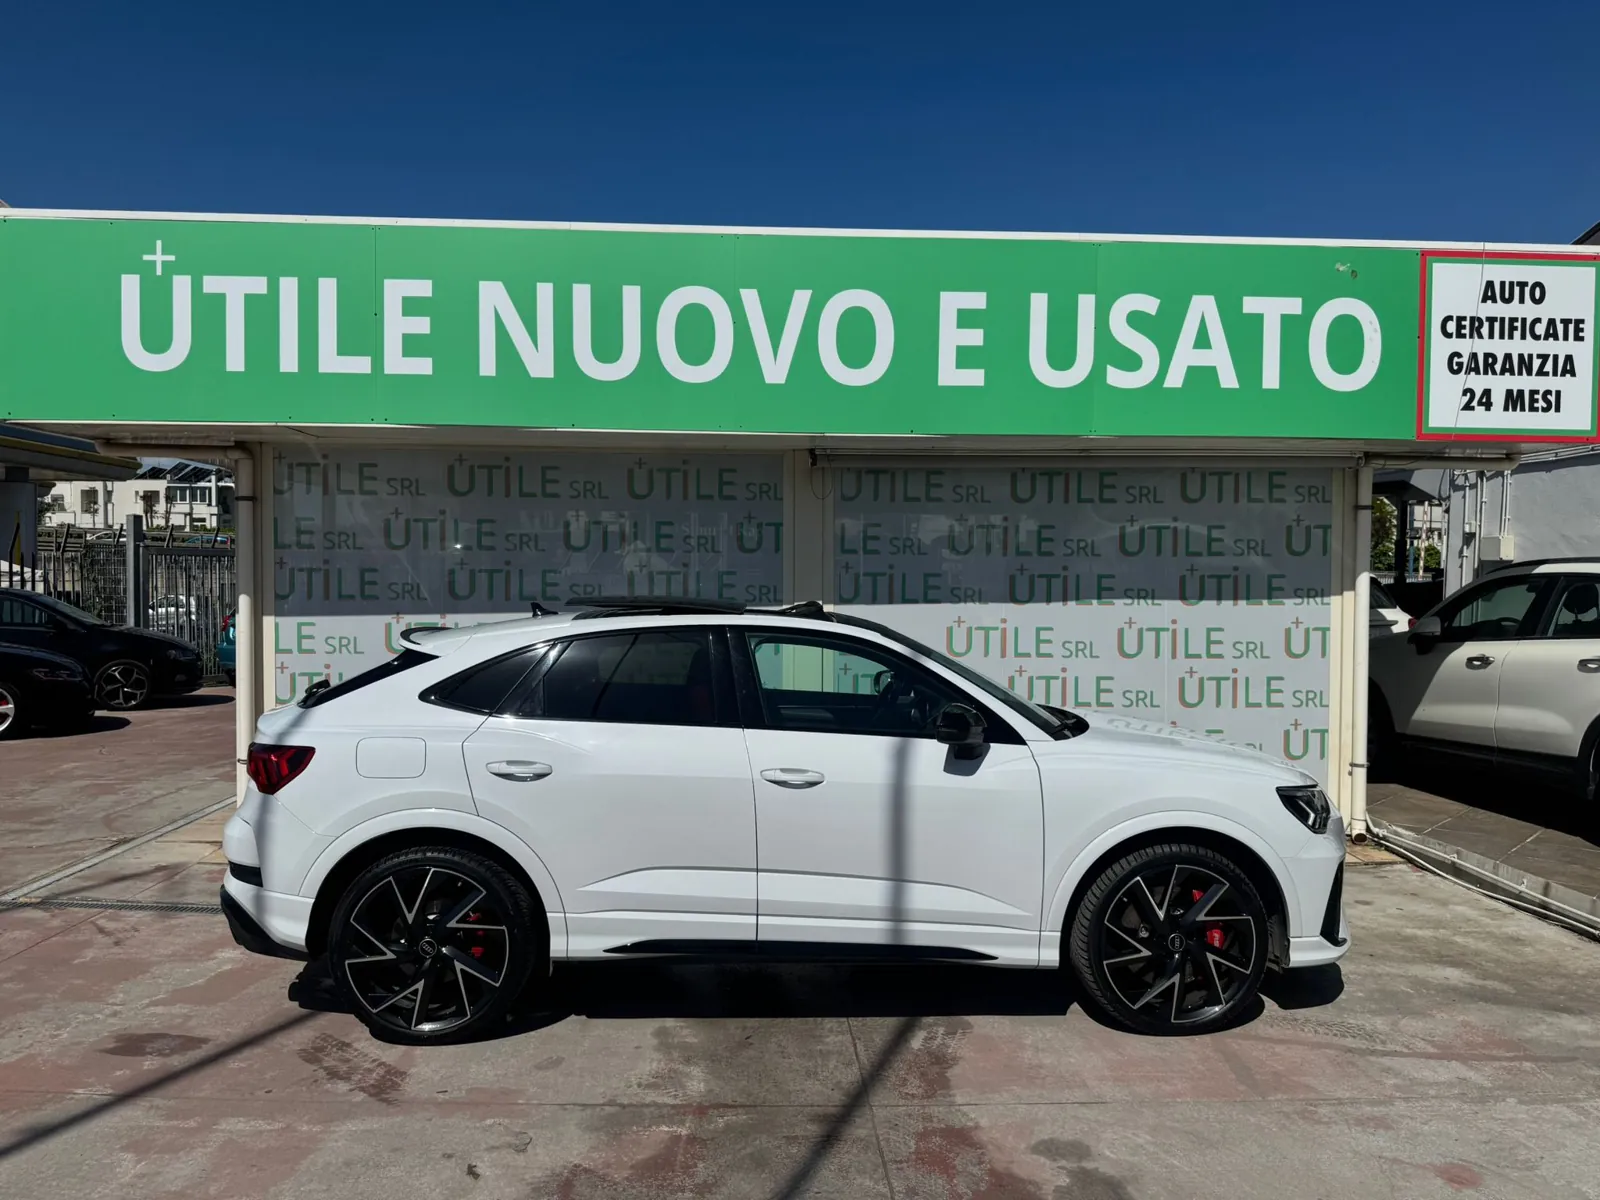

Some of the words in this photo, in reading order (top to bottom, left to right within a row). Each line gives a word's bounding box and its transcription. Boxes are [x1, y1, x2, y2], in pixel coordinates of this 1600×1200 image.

[1481, 280, 1547, 305] AUTO
[479, 281, 895, 387] NUOVO
[938, 291, 987, 387] E
[1028, 293, 1382, 392] USATO
[1440, 315, 1586, 342] CERTIFICATE
[1447, 351, 1577, 378] GARANZIA
[1460, 387, 1493, 412] 24
[1503, 388, 1562, 413] MESI
[386, 477, 426, 496] SRL
[569, 480, 609, 499] SRL
[745, 482, 783, 501] SRL
[952, 485, 991, 503] SRL
[1125, 485, 1164, 504] SRL
[1294, 485, 1332, 503] SRL
[323, 532, 364, 550] SRL
[505, 533, 546, 551] SRL
[683, 535, 722, 554] SRL
[889, 537, 928, 556] SRL
[1063, 538, 1101, 557] SRL
[1232, 539, 1272, 557] SRL
[388, 582, 427, 601] SRL
[745, 585, 783, 603] SRL
[950, 587, 990, 605] SRL
[1123, 588, 1162, 606] SRL
[1293, 588, 1330, 606] SRL
[324, 636, 364, 654] SRL
[1061, 641, 1100, 659] SRL
[1232, 641, 1271, 659] SRL
[1122, 690, 1160, 708] SRL
[1292, 690, 1329, 708] SRL
